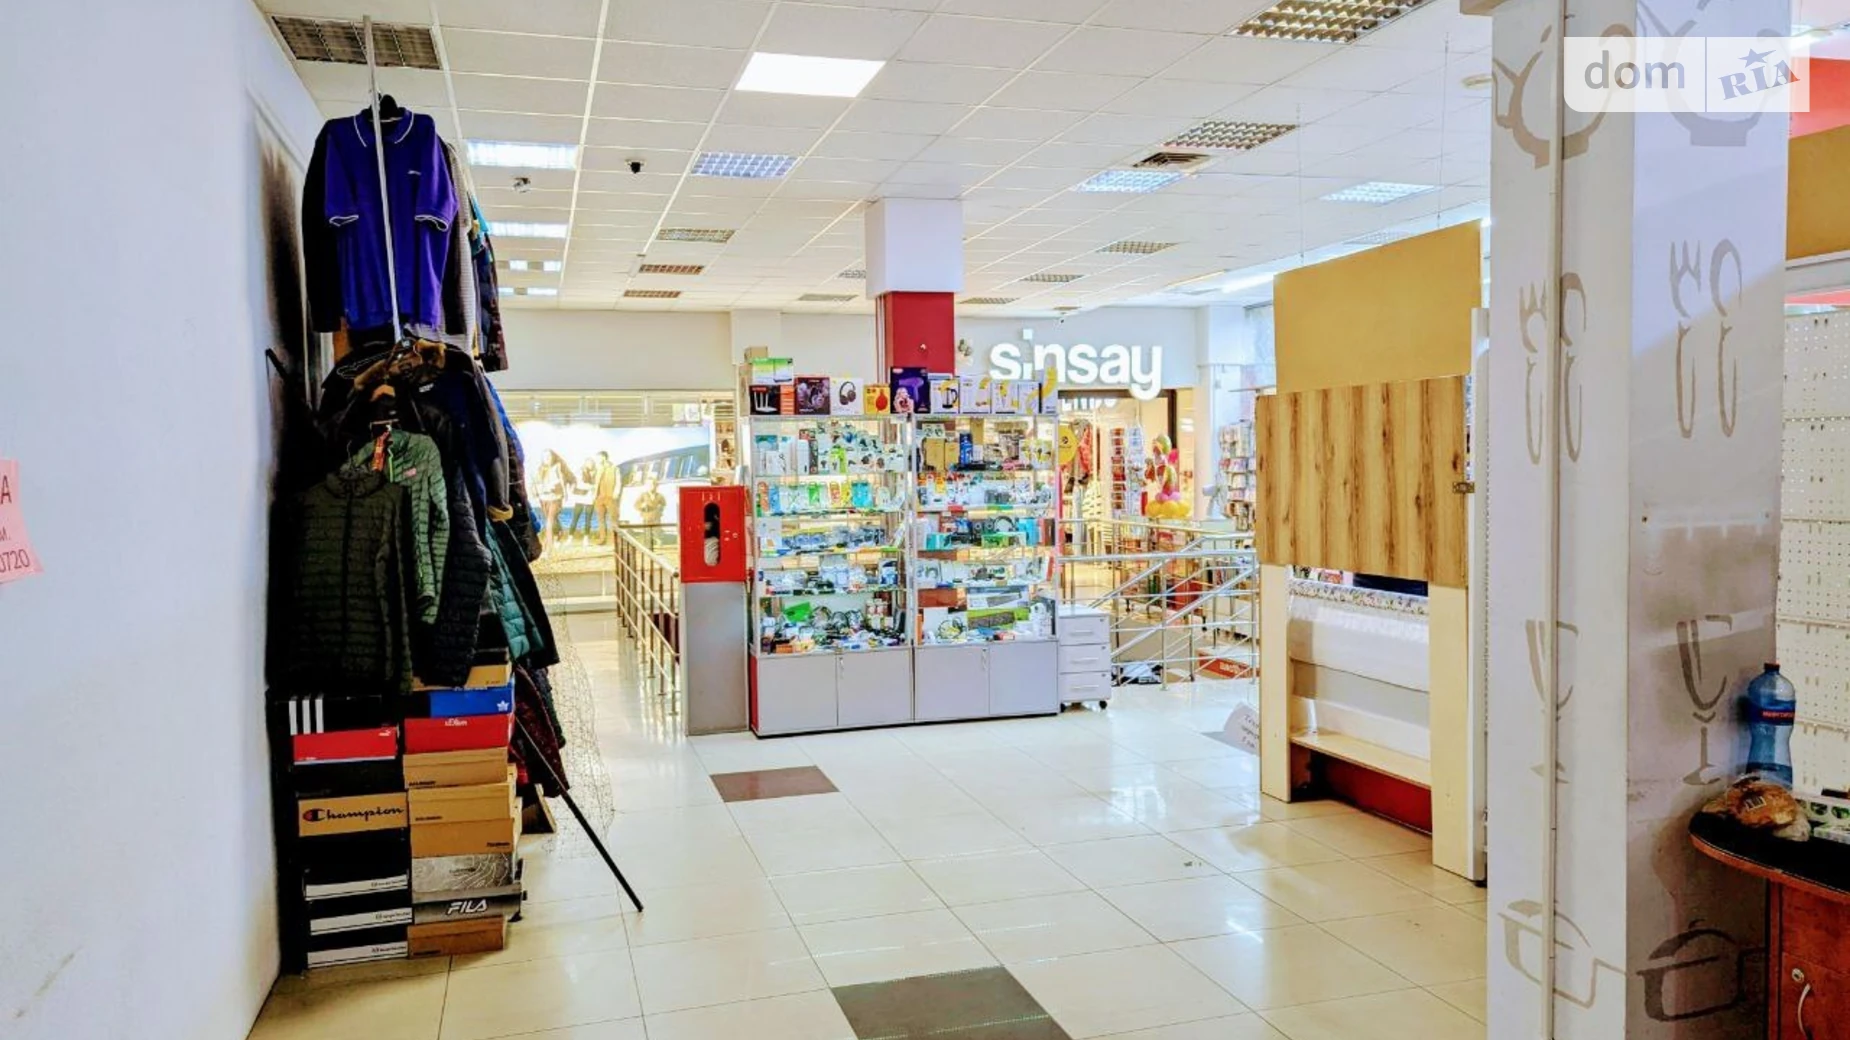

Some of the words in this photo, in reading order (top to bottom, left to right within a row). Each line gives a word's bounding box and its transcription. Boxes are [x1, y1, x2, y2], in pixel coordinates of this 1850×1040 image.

[989, 328, 1163, 401] sinsay
[302, 806, 404, 822] Champion
[446, 898, 488, 915] FILA
